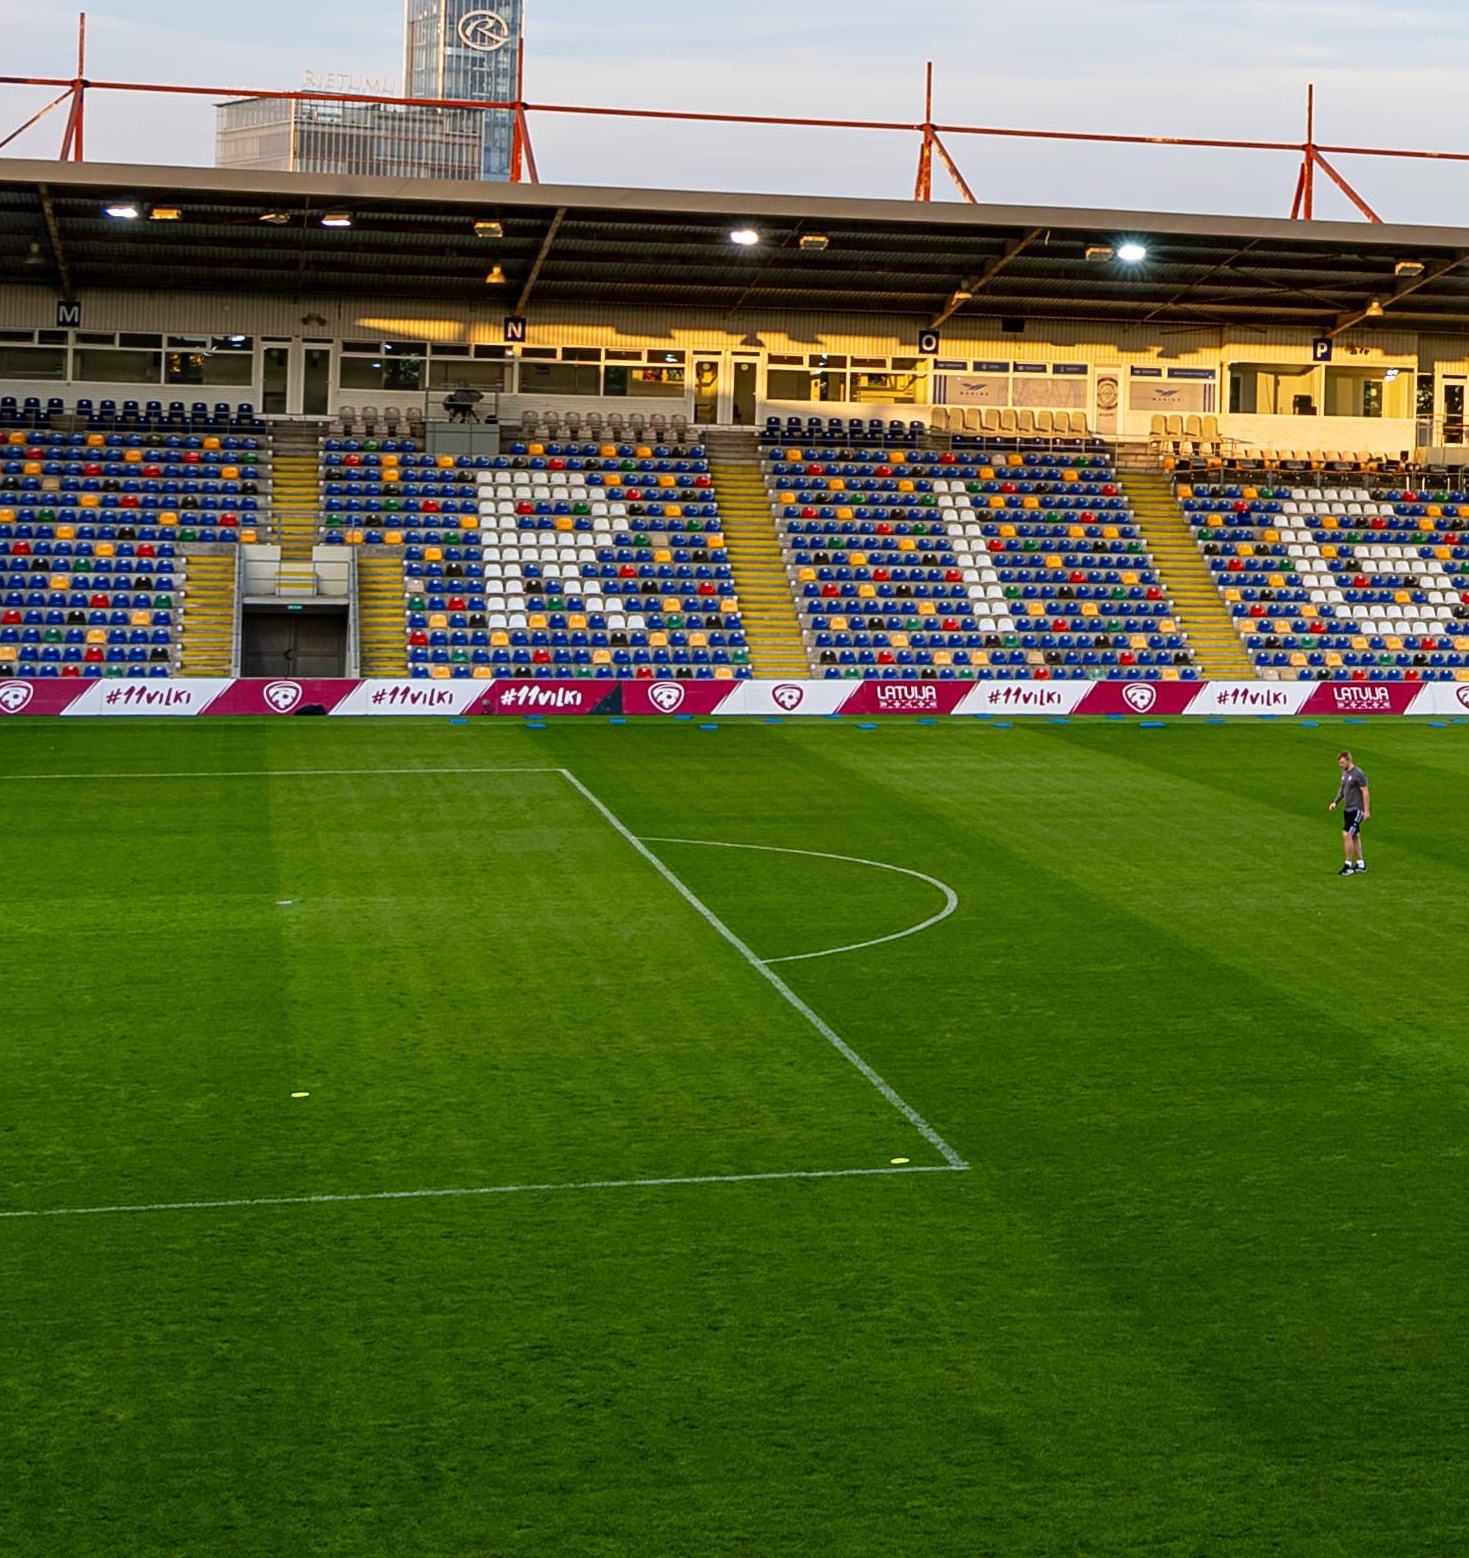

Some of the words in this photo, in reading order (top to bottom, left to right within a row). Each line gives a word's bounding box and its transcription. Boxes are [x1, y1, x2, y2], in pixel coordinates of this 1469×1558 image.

[59, 305, 79, 323] M
[507, 320, 522, 339] N
[921, 334, 936, 351] O
[1316, 342, 1328, 358] P
